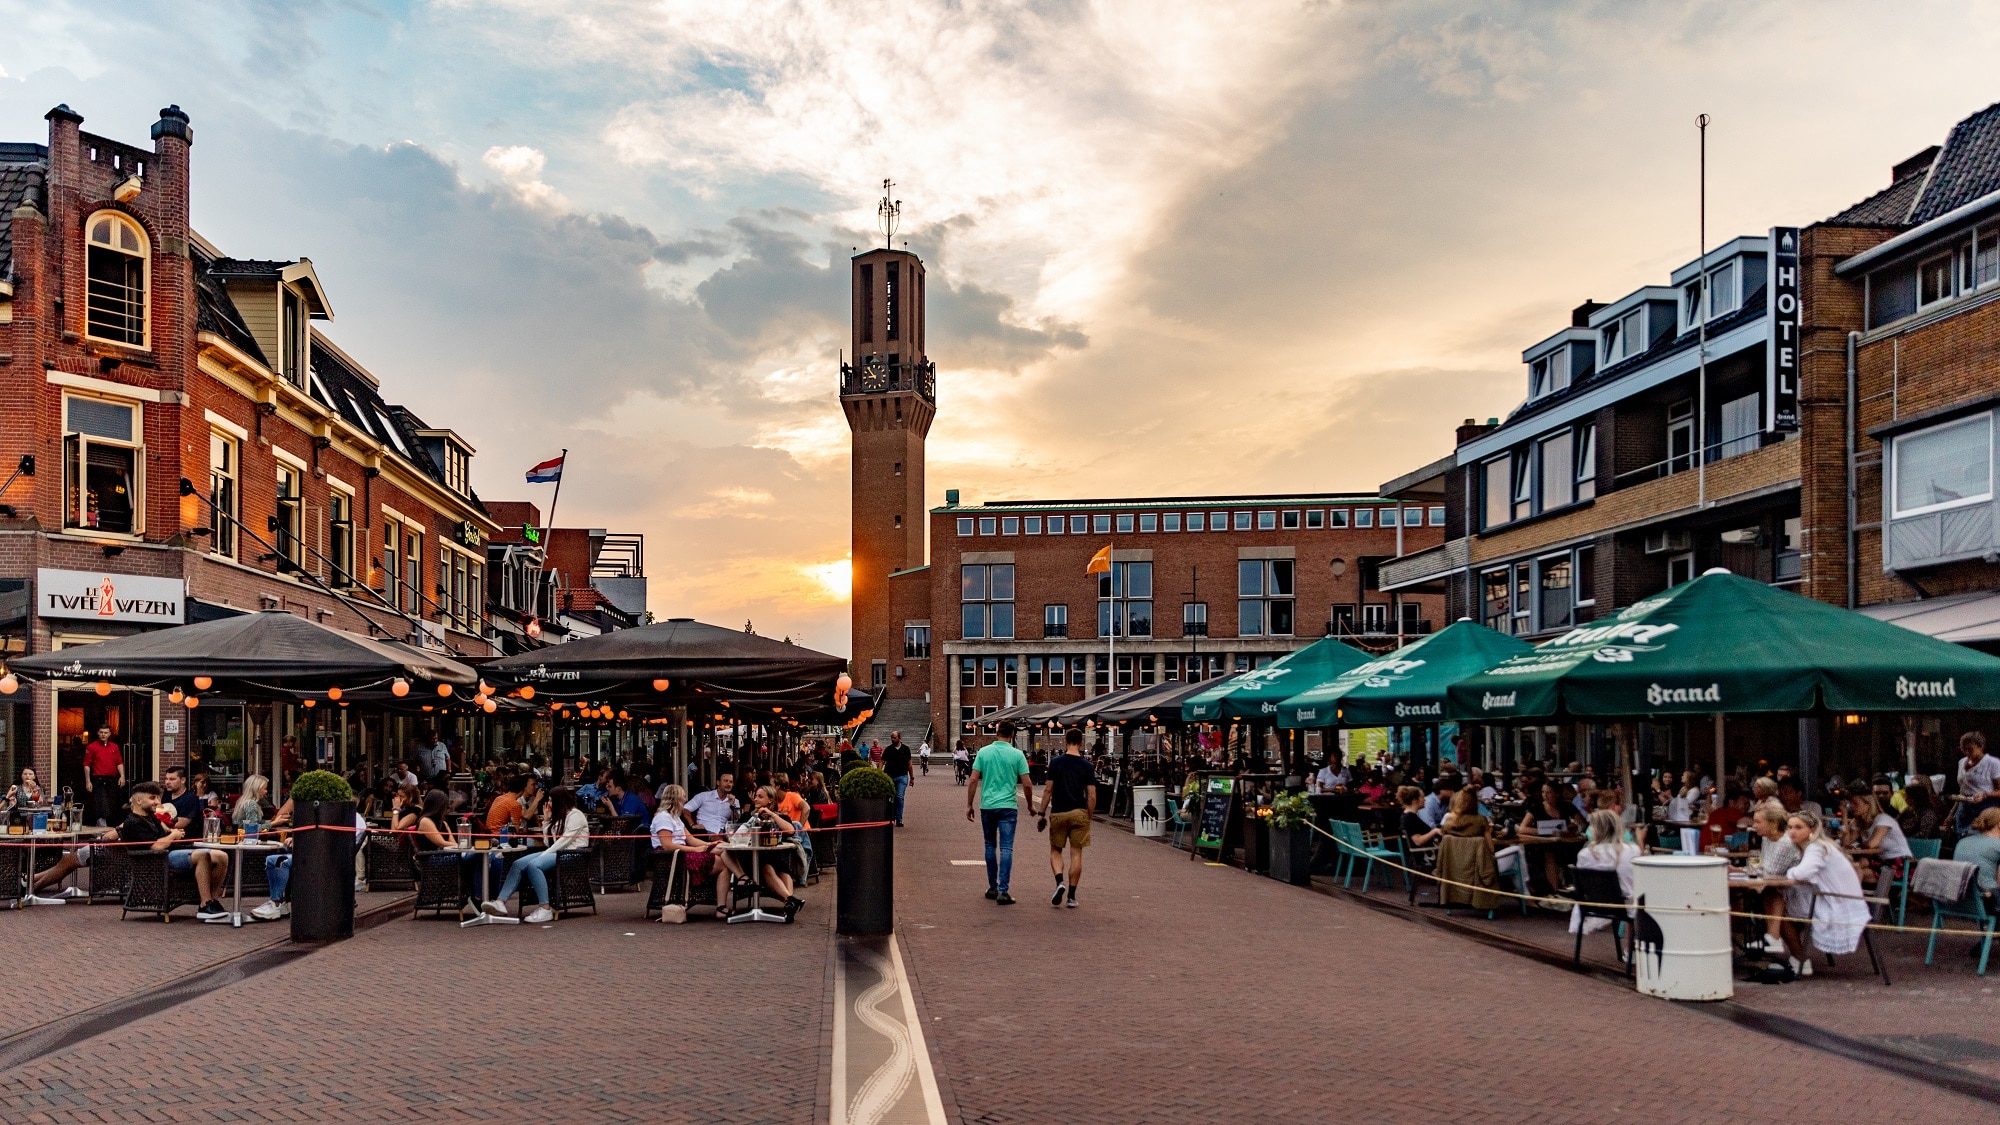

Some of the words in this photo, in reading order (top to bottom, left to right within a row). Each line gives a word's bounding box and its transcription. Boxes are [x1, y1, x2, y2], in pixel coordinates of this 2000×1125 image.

[1777, 266, 1796, 395] HOTEL
[86, 587, 98, 596] DE
[47, 593, 99, 611] TWEE
[115, 599, 176, 616] WEZEN
[1646, 683, 1721, 706] Brand
[1894, 675, 1957, 700] Brand
[1261, 702, 1278, 714] Bra
[1395, 702, 1442, 718] Brand
[1482, 690, 1517, 711] Brand
[1296, 708, 1316, 722] Brand
